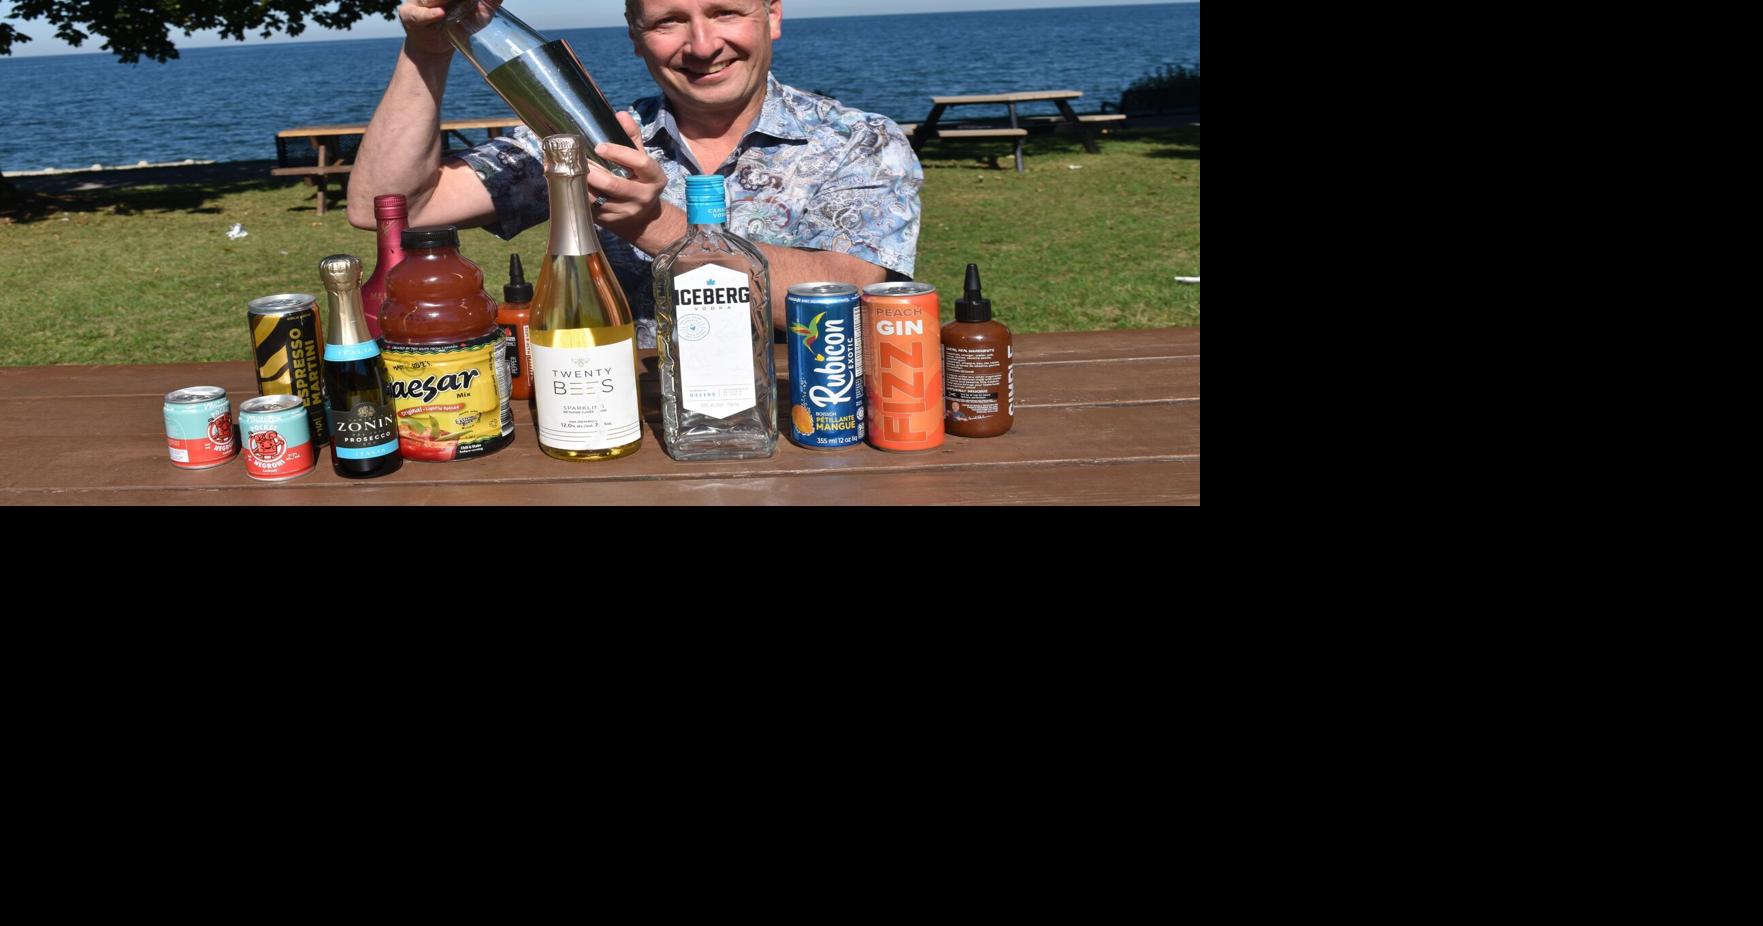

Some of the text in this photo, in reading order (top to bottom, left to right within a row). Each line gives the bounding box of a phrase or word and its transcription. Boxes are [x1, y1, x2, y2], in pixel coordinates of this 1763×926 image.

[674, 287, 750, 306] ICEBERG
[876, 308, 922, 316] PEACH
[876, 320, 923, 336] GIN
[290, 328, 310, 408] ESPRESSO
[808, 319, 854, 408] Rubicon
[304, 340, 322, 406] MARTINI
[552, 368, 612, 378] TWENTY
[386, 368, 480, 403] aesar
[880, 342, 927, 441] FIZZ
[337, 414, 392, 432] ZONIN
[816, 414, 854, 422] PÉTILLANTE
[816, 421, 856, 430] MANGUE
[344, 432, 390, 442] PROSECCO
[254, 460, 286, 469] NEGRONI
